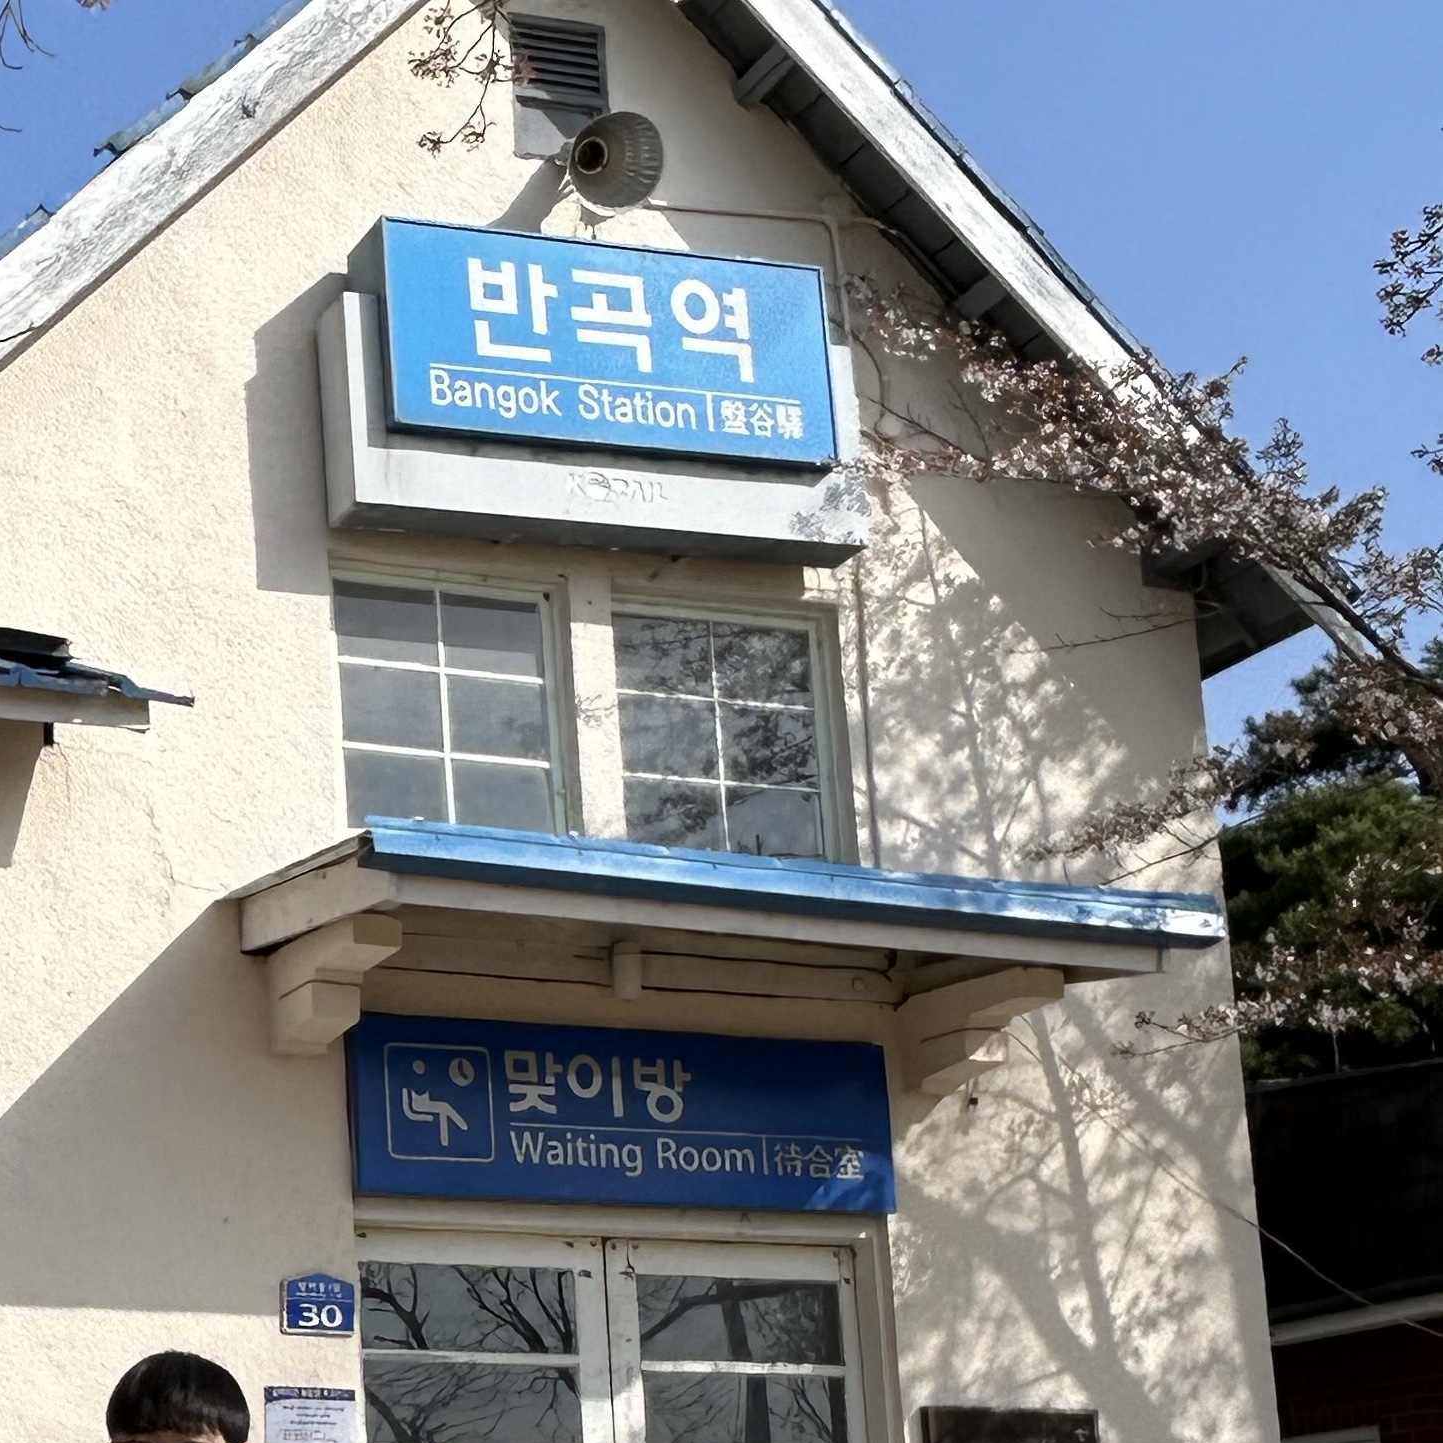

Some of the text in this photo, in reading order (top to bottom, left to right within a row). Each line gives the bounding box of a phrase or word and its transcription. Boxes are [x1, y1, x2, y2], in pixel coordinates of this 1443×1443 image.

[467, 256, 755, 383] 반곡역
[429, 368, 698, 431] Bangok Station
[504, 1050, 692, 1124] 맞이방
[509, 1130, 756, 1178] Waiting Room
[298, 1303, 343, 1328] 30
